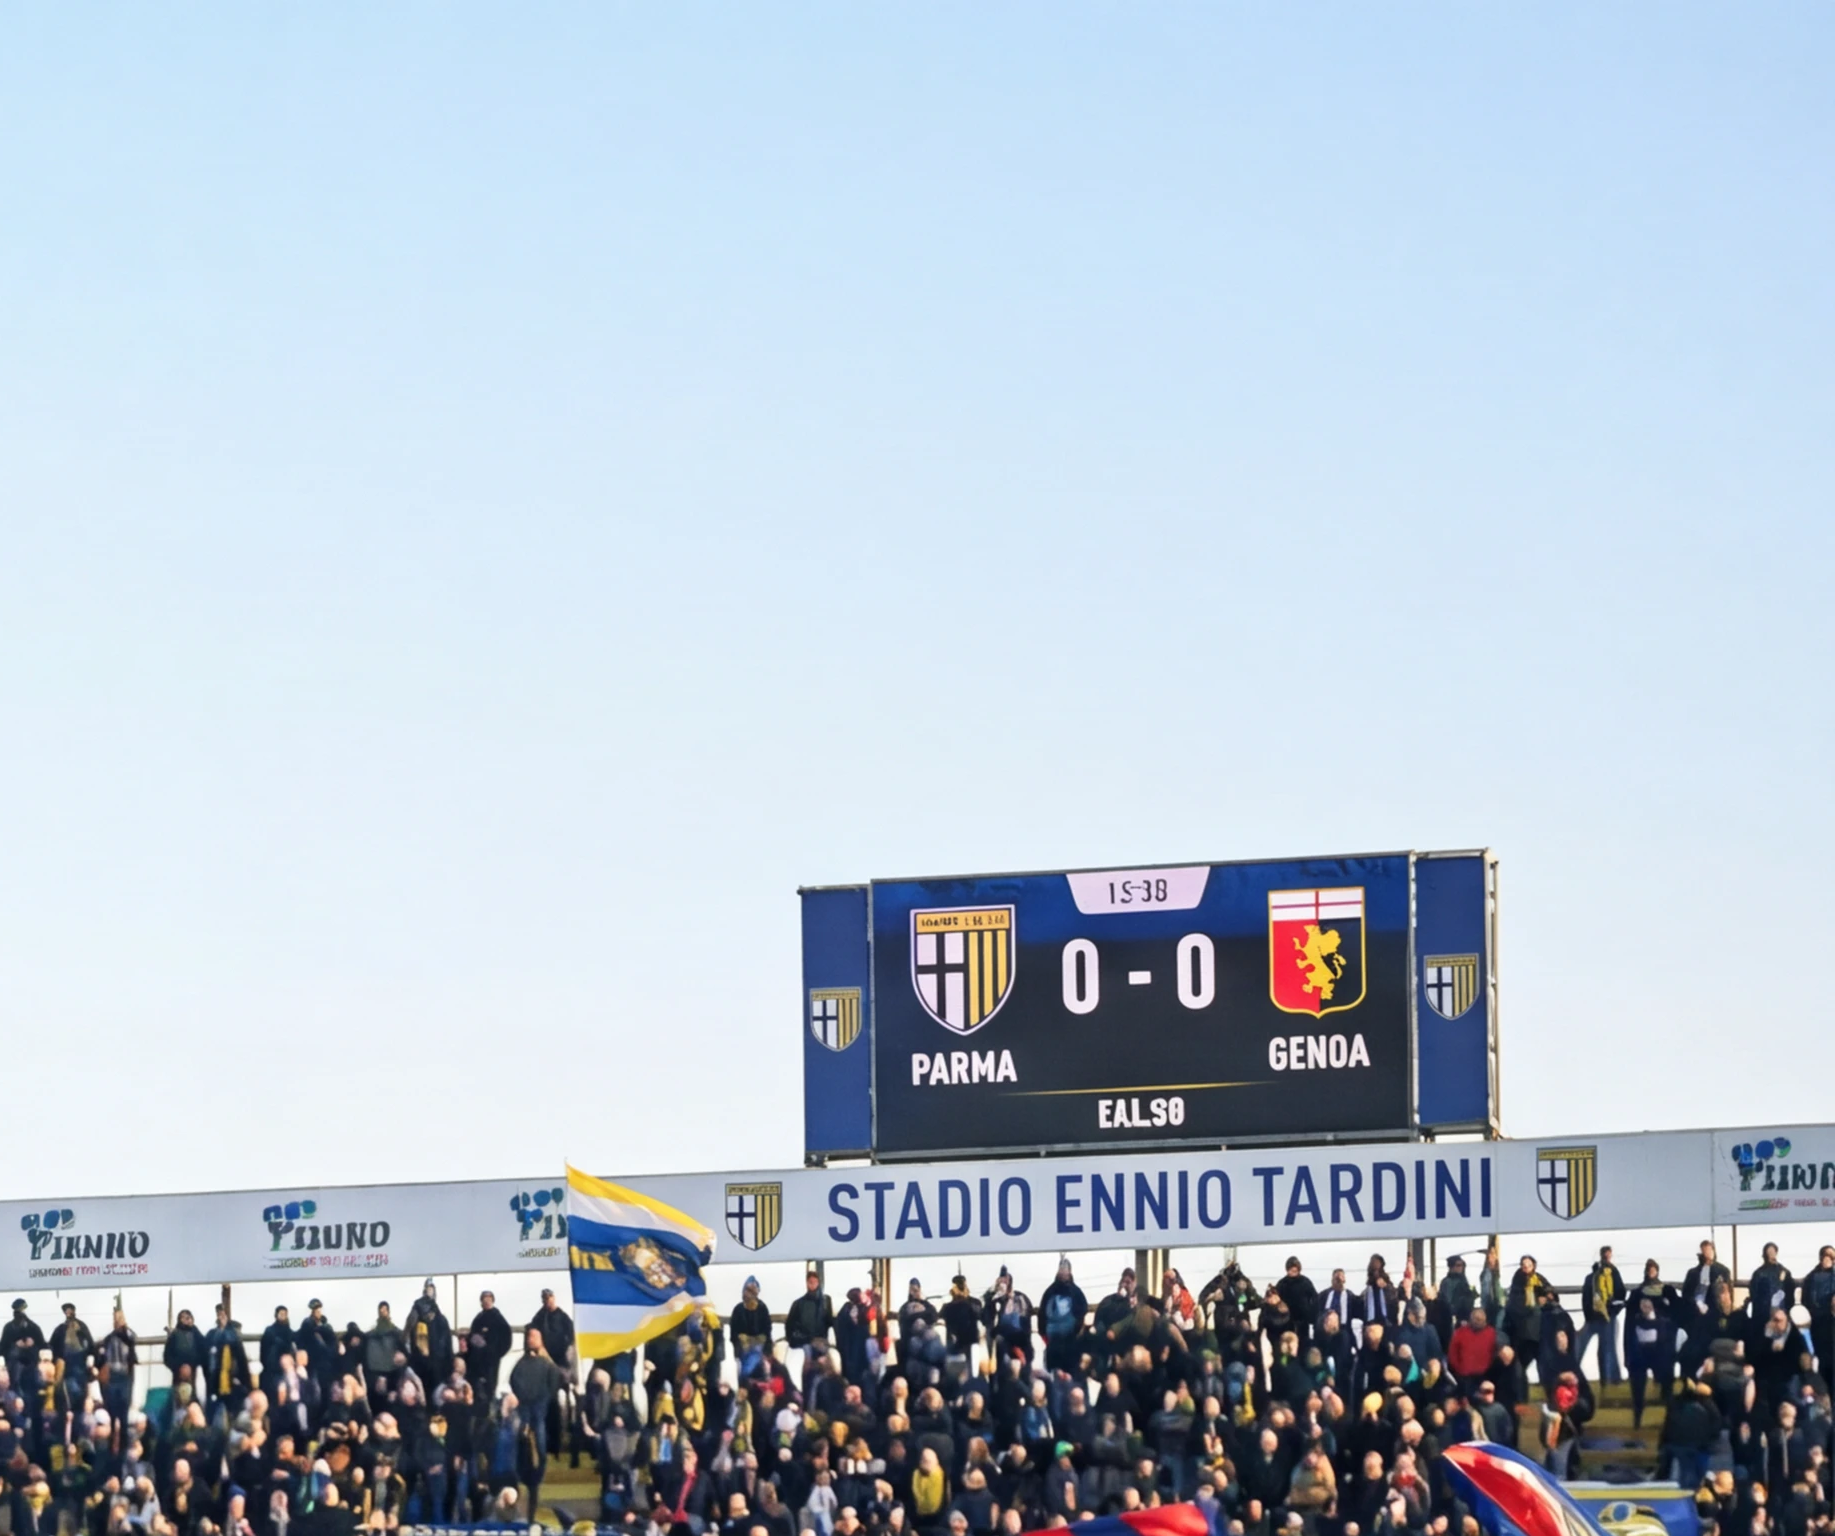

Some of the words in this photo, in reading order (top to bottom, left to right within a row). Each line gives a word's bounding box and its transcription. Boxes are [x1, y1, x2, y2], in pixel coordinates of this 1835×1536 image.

[1062, 938, 1099, 1014] 0
[1177, 933, 1215, 1009] 0
[912, 1049, 1017, 1085] PARMA
[1268, 1033, 1370, 1071] GENOA
[827, 1177, 1032, 1243] STADIO
[1055, 1168, 1232, 1232] ENNIO
[1253, 1156, 1493, 1227] TARDINI
